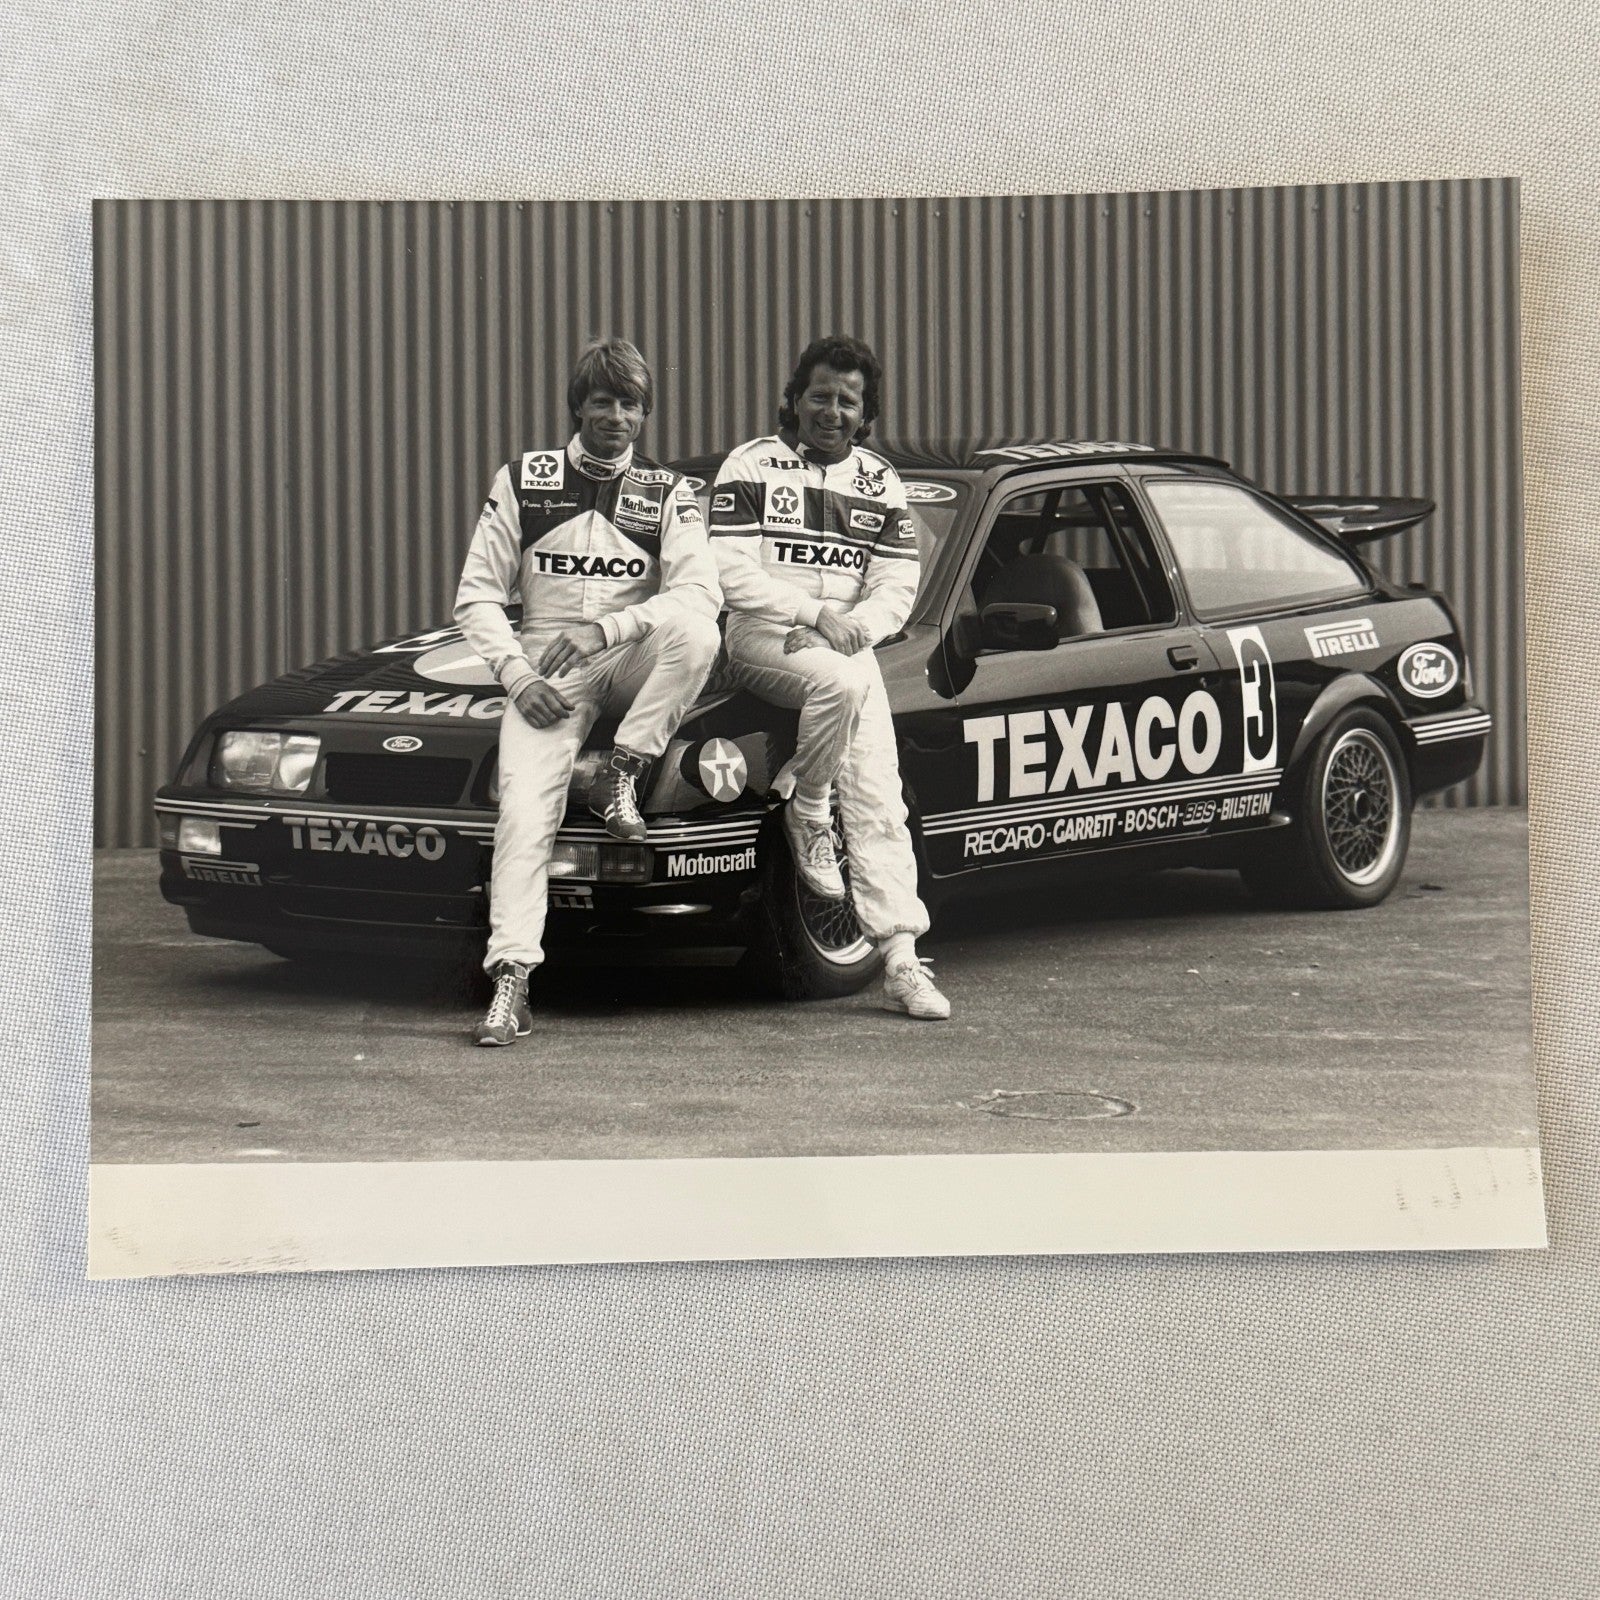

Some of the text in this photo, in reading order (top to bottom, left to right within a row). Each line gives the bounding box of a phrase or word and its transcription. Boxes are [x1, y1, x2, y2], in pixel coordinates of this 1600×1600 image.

[620, 497, 659, 515] Marlboro
[767, 515, 802, 525] TEXACO
[534, 551, 646, 578] TEXACO
[774, 541, 864, 569] TEXACO
[1304, 618, 1380, 658] PIRELLI
[1411, 652, 1448, 685] Ford
[323, 690, 507, 720] TEXAC
[1240, 638, 1274, 761] 3
[963, 690, 1222, 802] TEXACO
[282, 816, 447, 861] TEXACO
[181, 855, 263, 886] PIRELLI
[667, 848, 757, 878] Motorcraft
